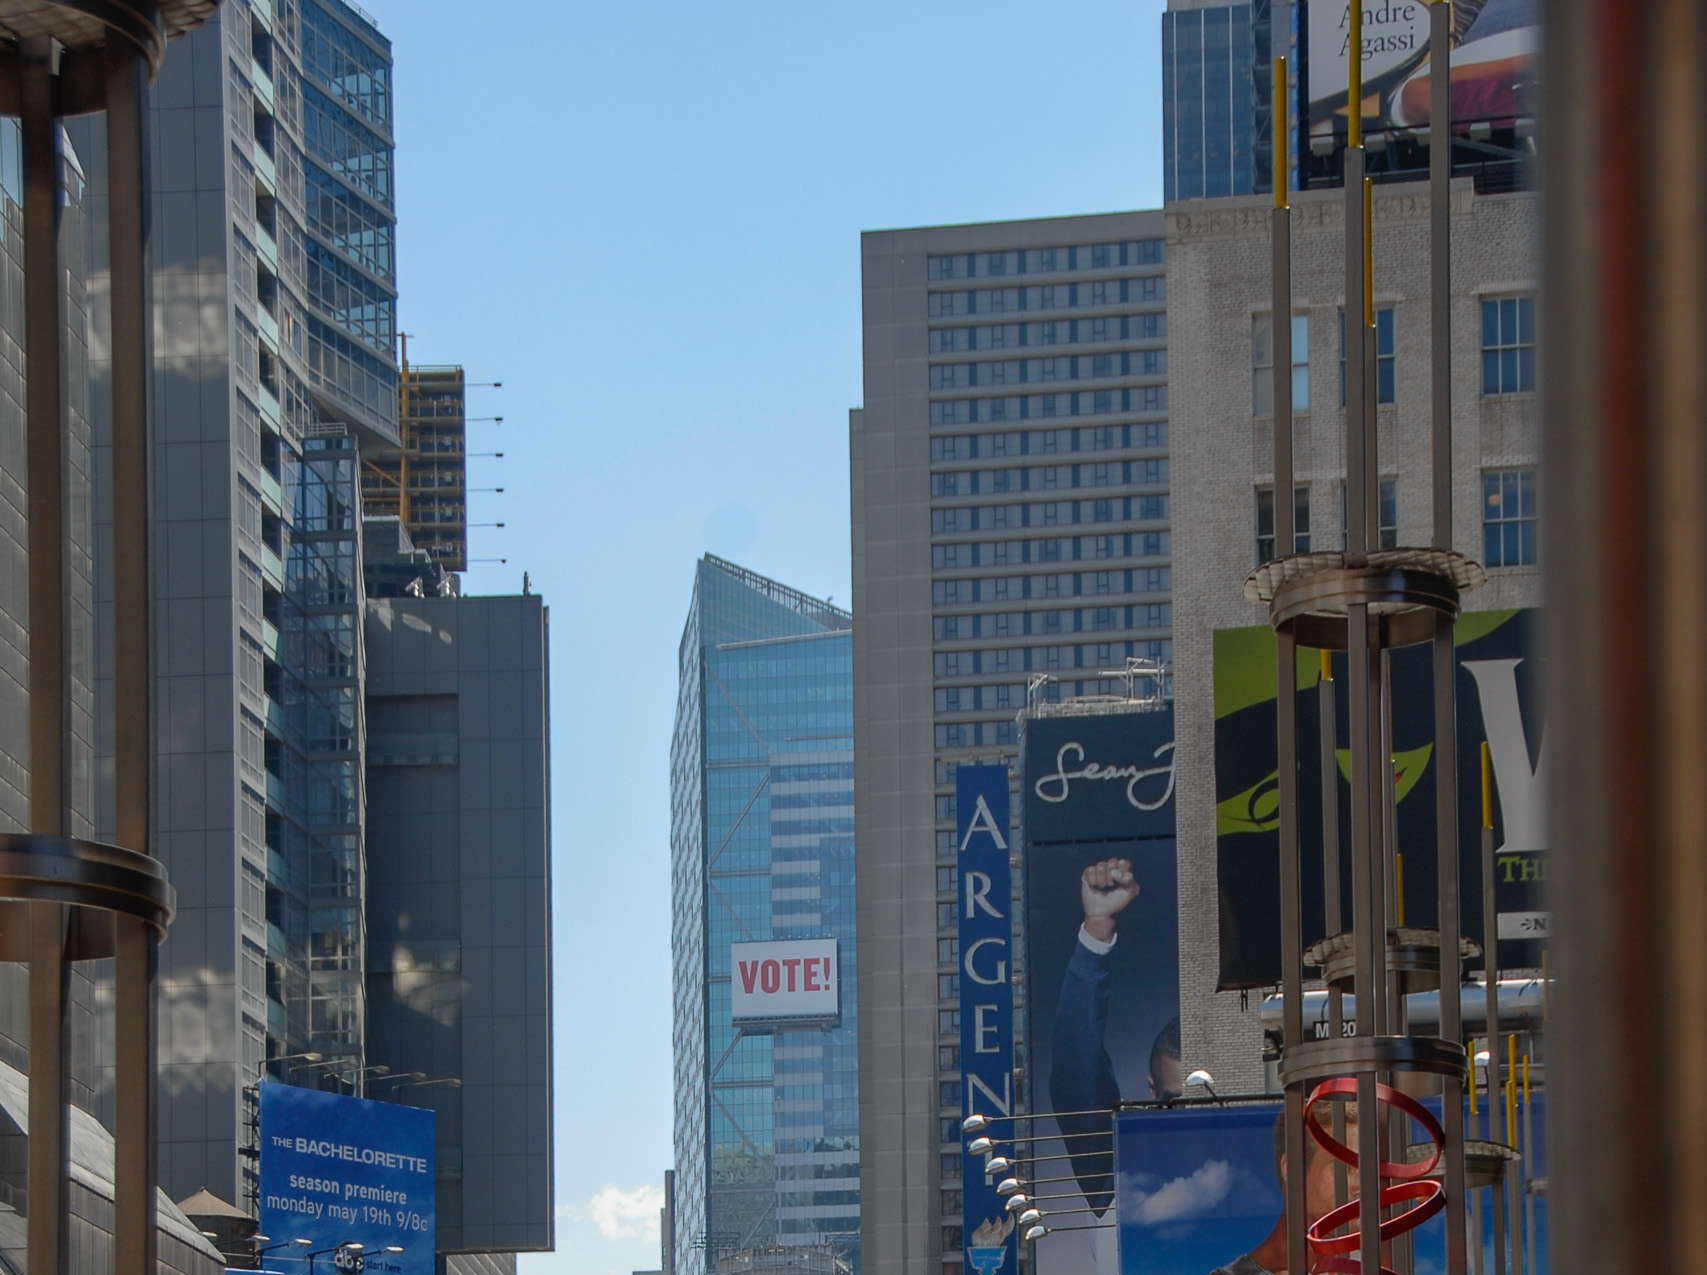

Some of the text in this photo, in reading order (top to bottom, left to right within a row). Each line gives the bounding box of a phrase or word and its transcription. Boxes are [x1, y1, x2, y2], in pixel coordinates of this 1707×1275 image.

[738, 957, 831, 994] VOTE!
[272, 1136, 428, 1174] THE BACHELORETTE
[289, 1174, 408, 1205] season premiere
[266, 1195, 429, 1232] monday may 19th 9/8c
[366, 1259, 384, 1271] start
[384, 1260, 402, 1273] here
